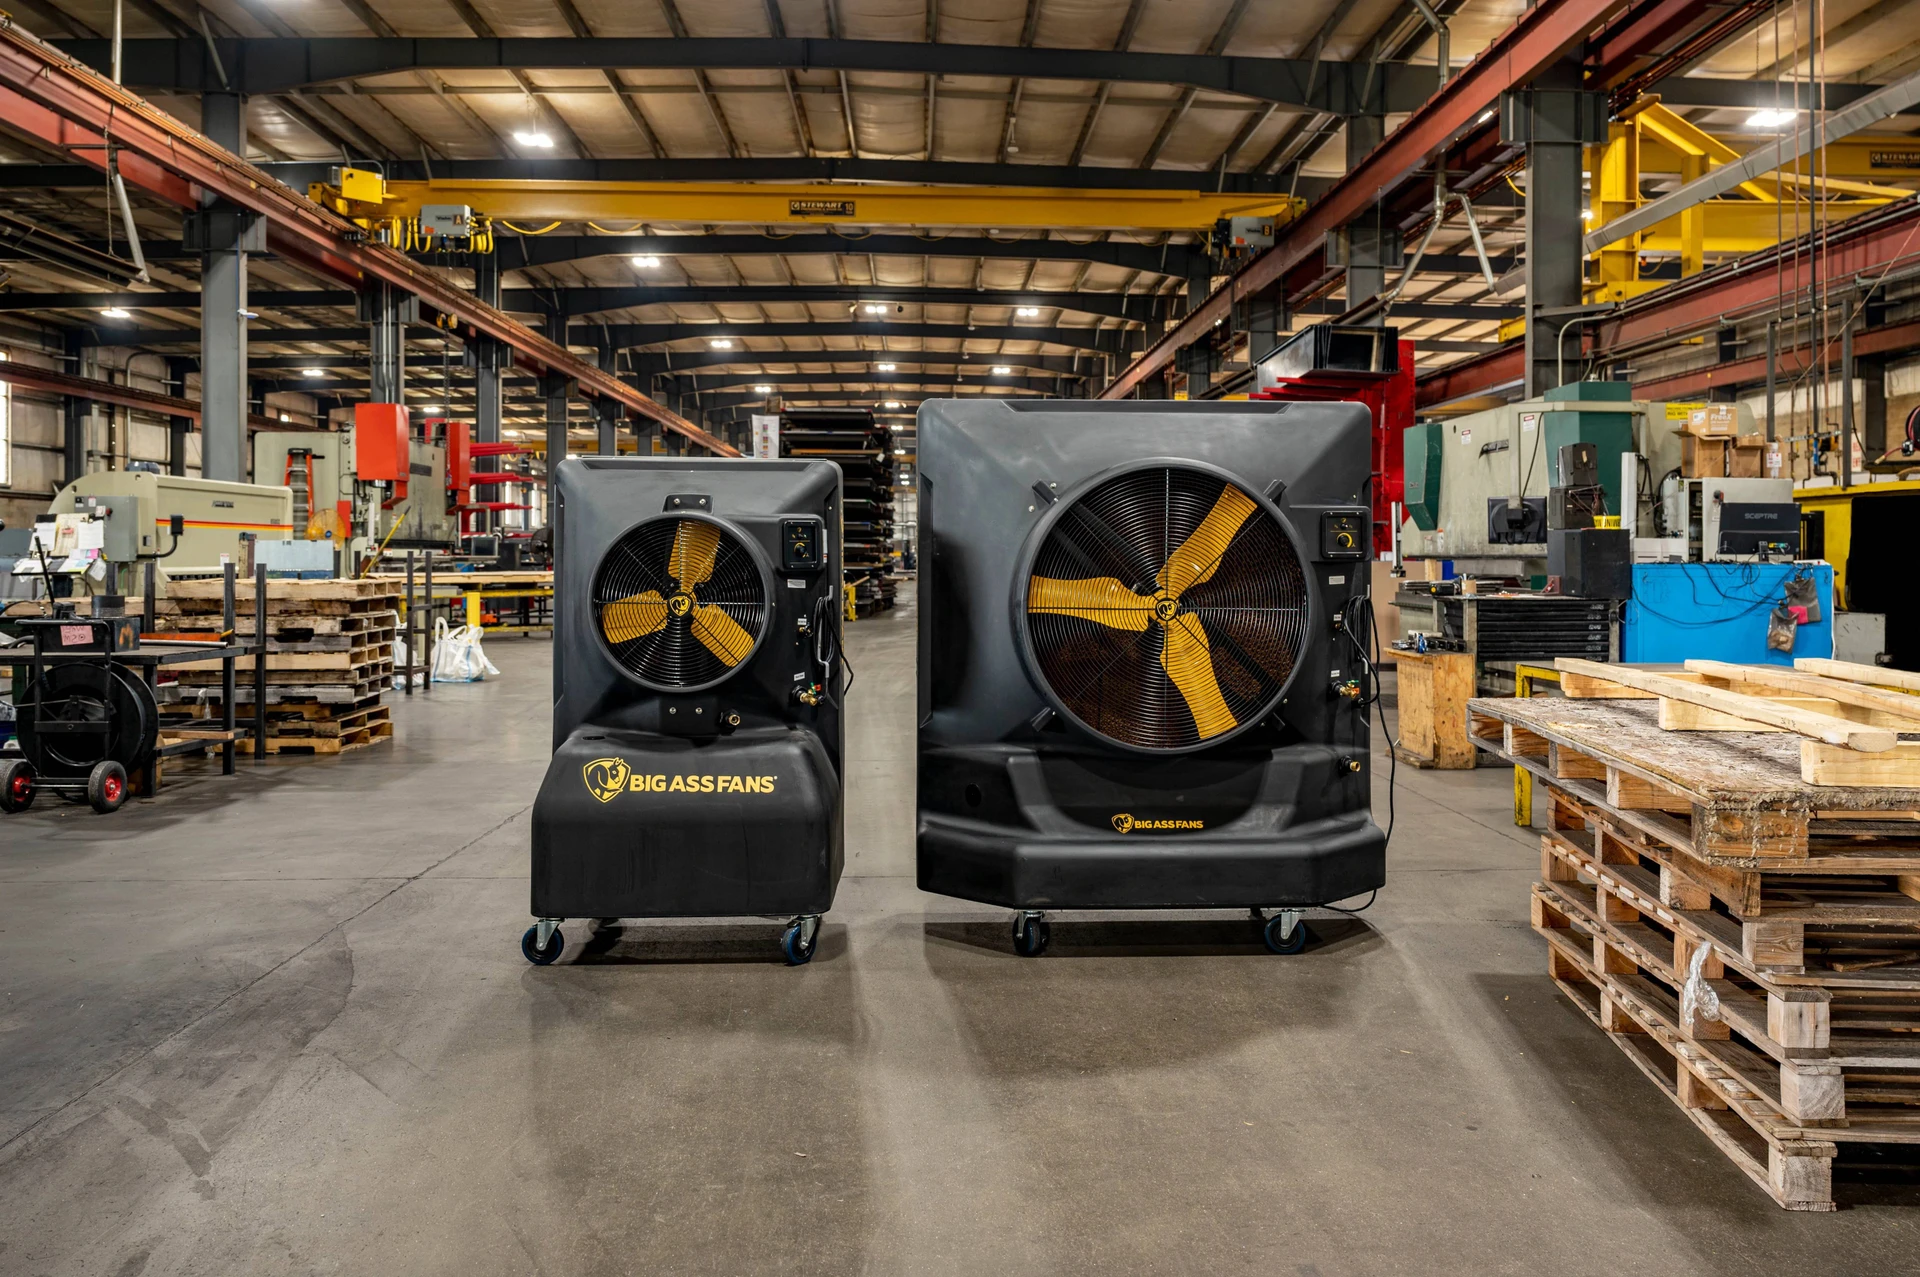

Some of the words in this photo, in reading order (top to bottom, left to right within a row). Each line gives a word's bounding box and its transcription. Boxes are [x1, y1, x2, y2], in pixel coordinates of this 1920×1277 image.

[845, 203, 854, 211] 10
[455, 214, 462, 225] A
[629, 774, 666, 792] BIG
[668, 775, 714, 793] ASS
[717, 775, 775, 793] FANS
[1134, 820, 1152, 829] BIG
[1153, 820, 1175, 829] ASS
[1176, 820, 1204, 829] FANS
